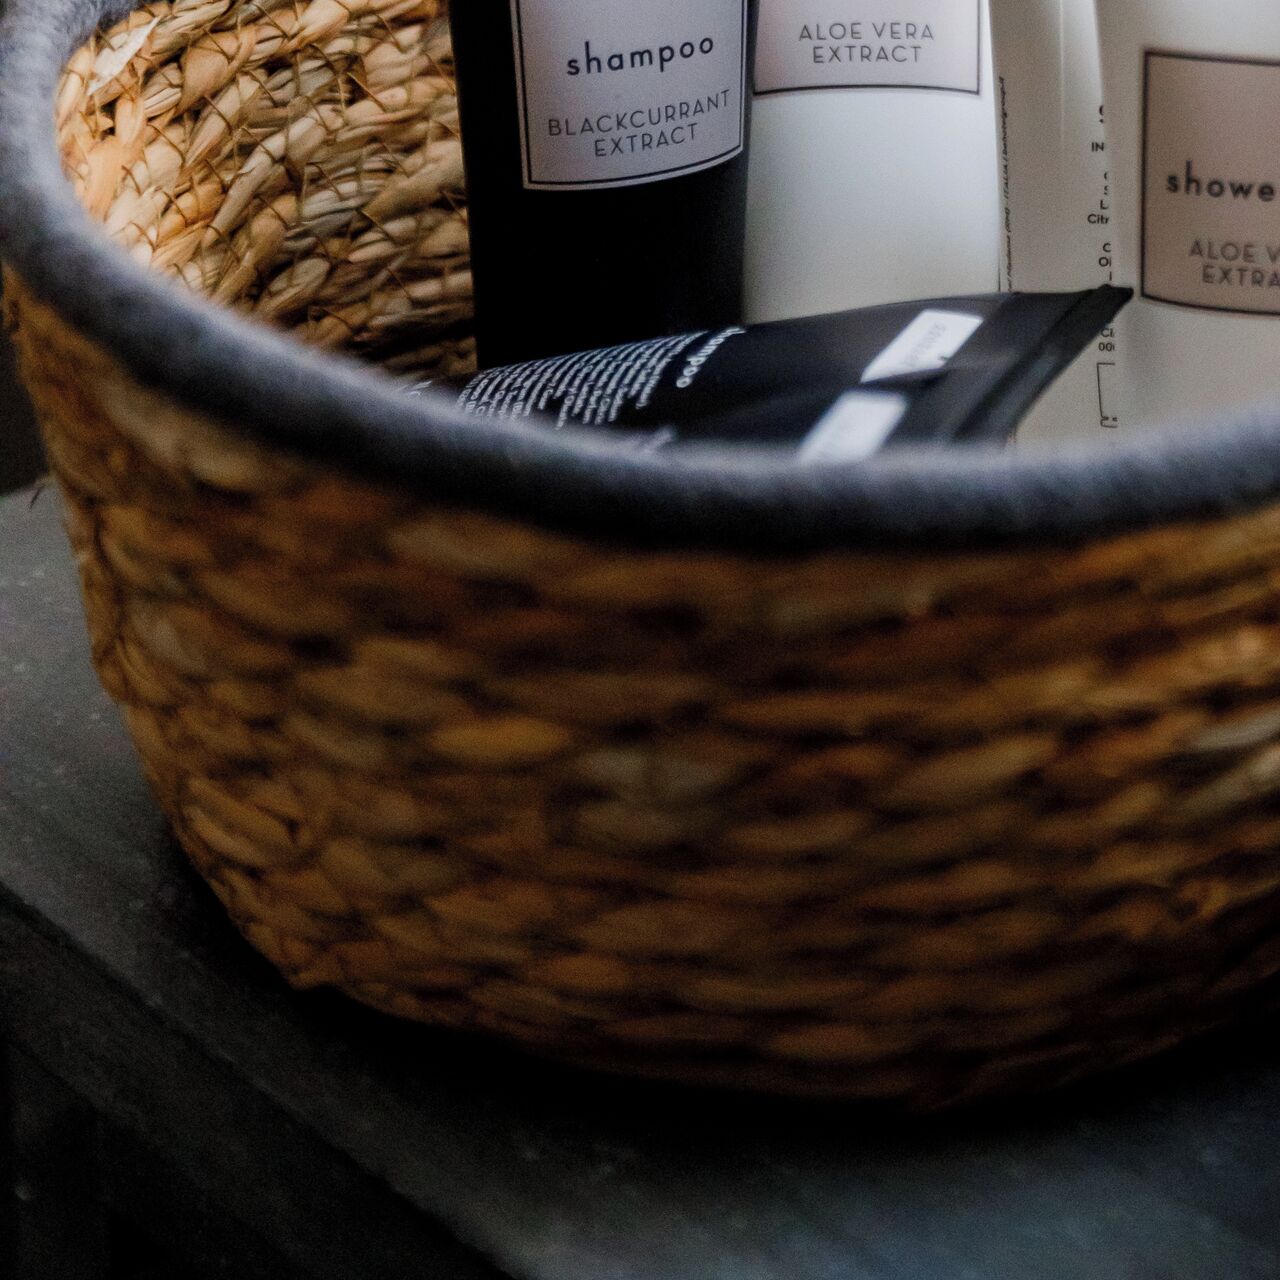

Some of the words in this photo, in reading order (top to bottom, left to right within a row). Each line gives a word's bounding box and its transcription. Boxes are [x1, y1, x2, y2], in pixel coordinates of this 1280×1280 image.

[798, 21, 863, 42] ALOE
[871, 21, 934, 41] VERA
[566, 37, 714, 76] shampoo
[812, 44, 922, 64] EXTRACT
[548, 88, 730, 137] BLACKCURRANT
[593, 122, 698, 158] EXTRACT
[1187, 237, 1257, 264] ALOE
[675, 327, 746, 389] hampoo
